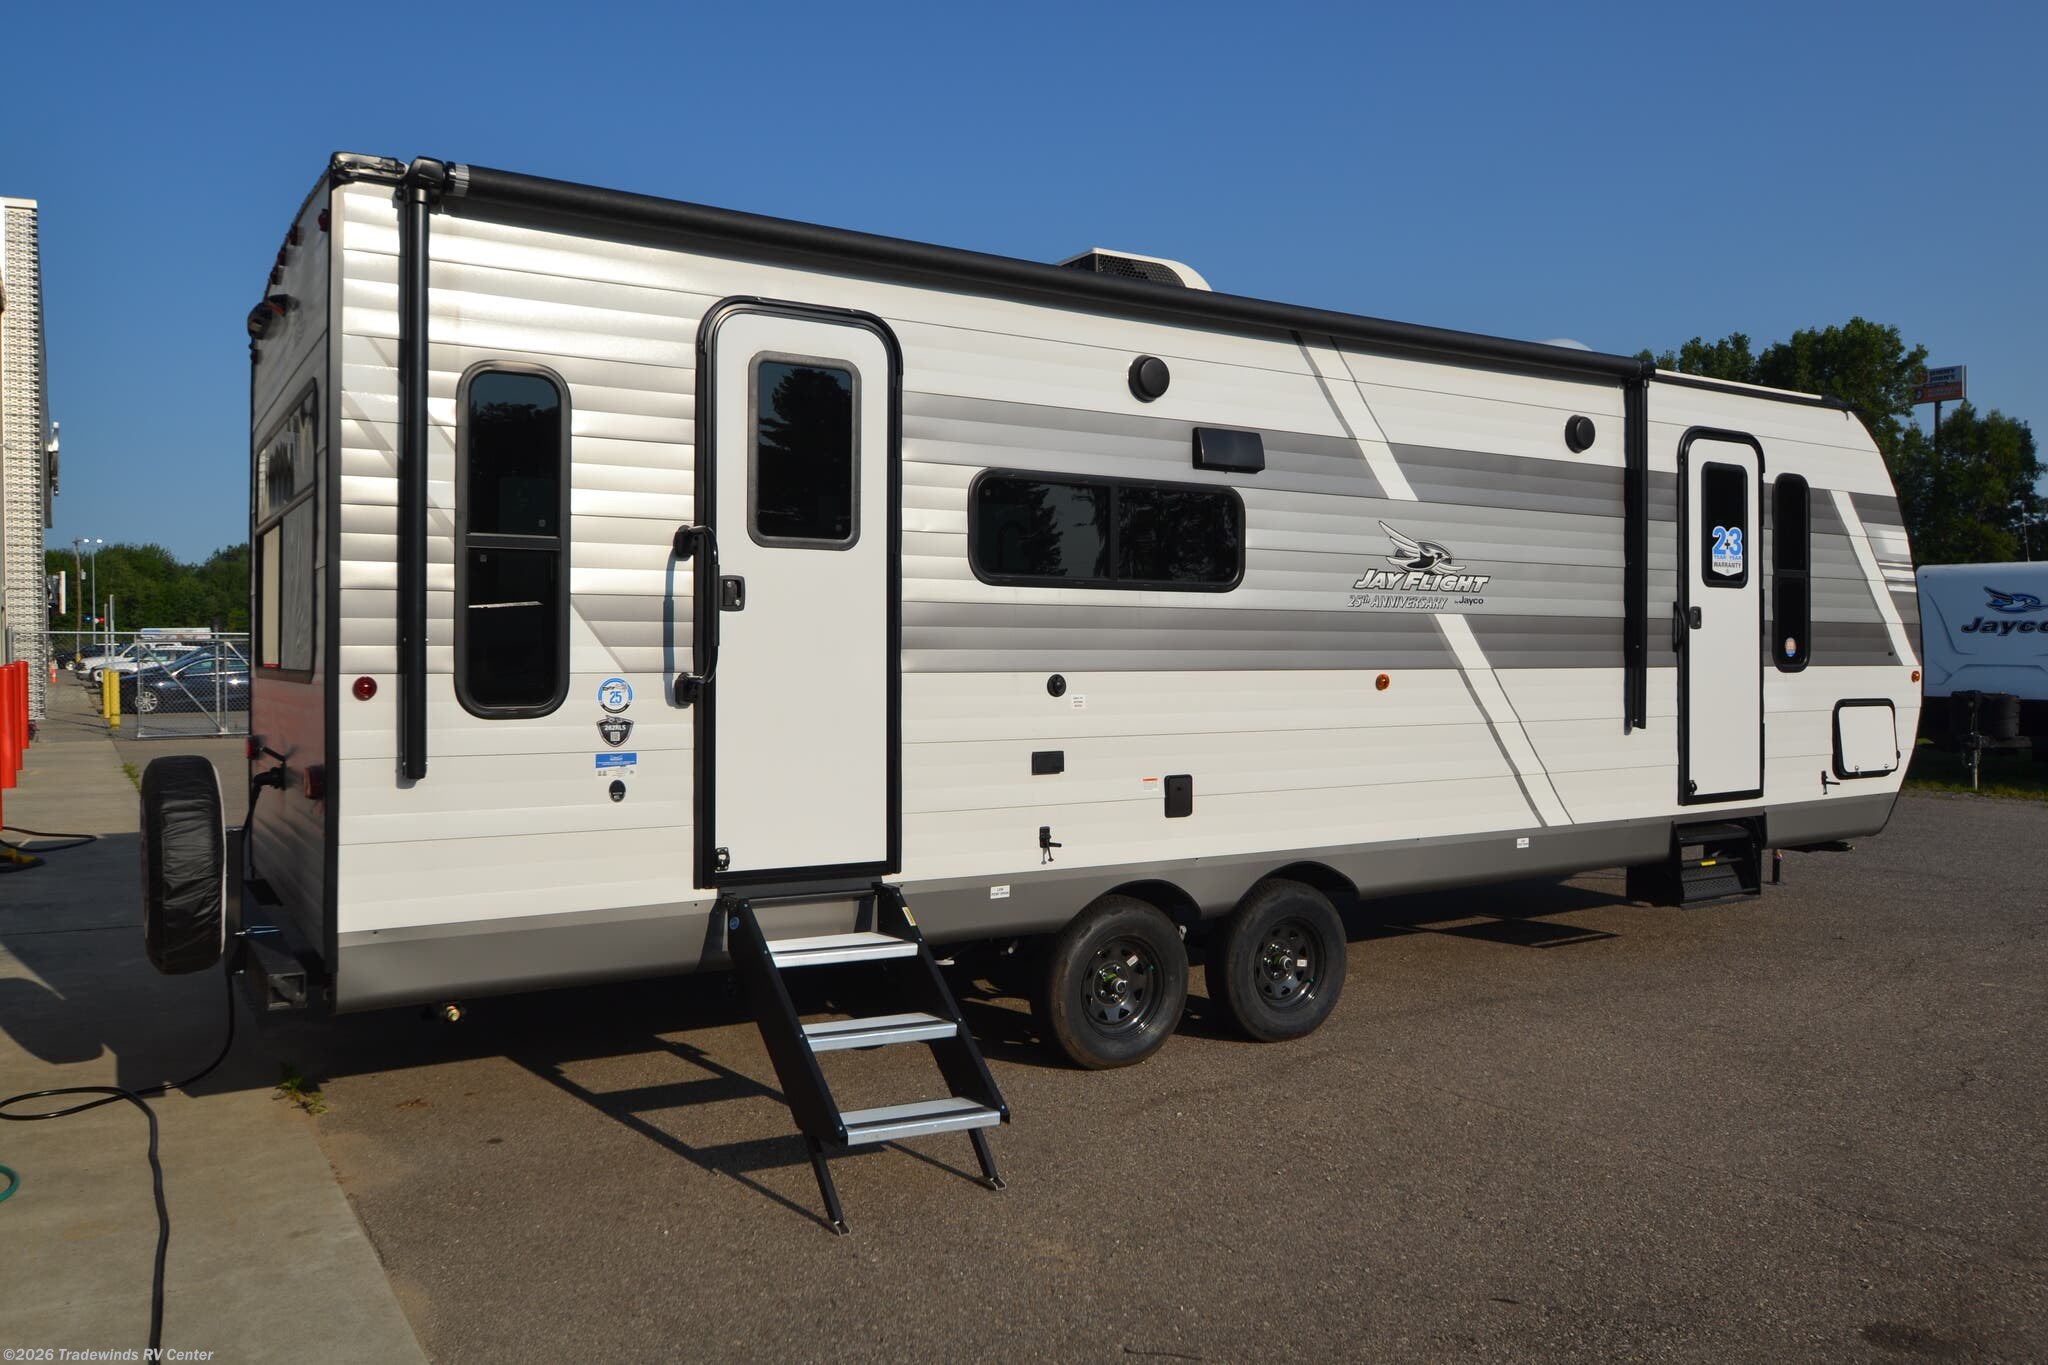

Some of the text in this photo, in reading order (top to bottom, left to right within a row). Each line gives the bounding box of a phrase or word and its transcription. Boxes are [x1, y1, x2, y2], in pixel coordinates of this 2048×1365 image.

[1353, 569, 1491, 593] JAY FLIGHT
[1370, 594, 1448, 609] ANNIVERSARY
[1459, 596, 1484, 606] Jayco
[610, 691, 622, 704] 25
